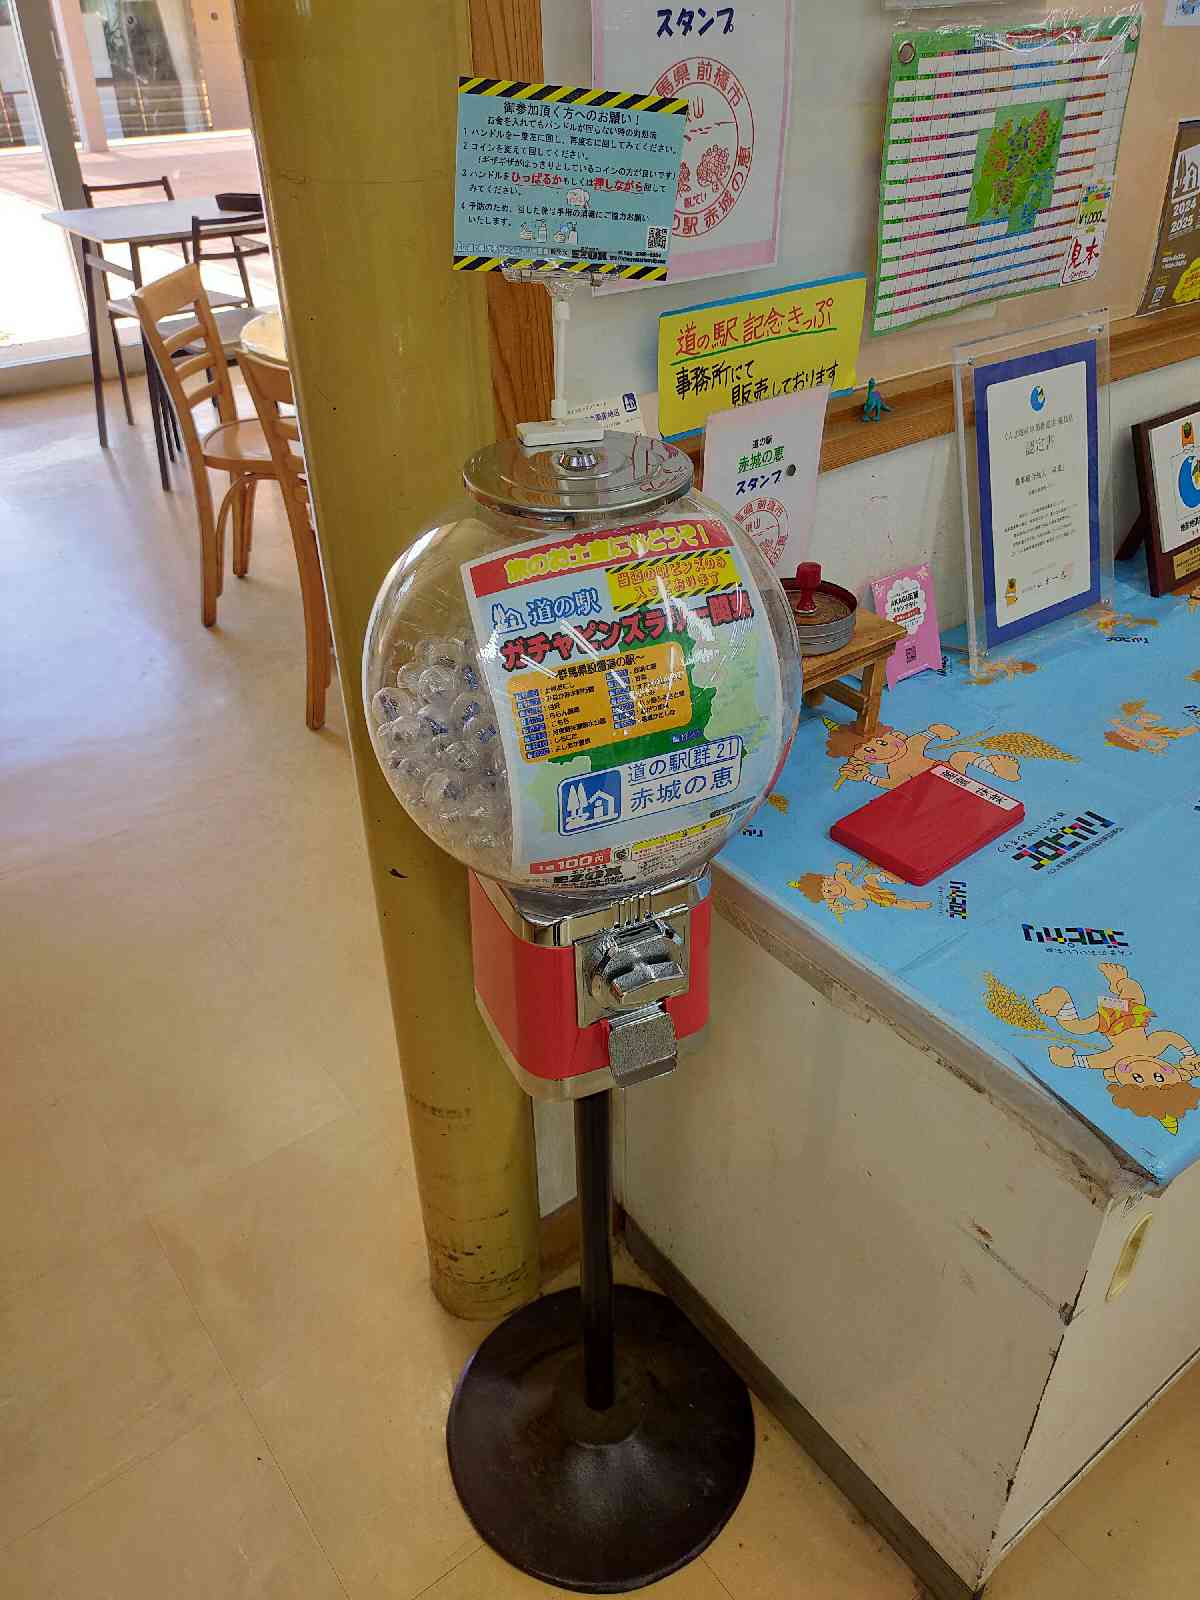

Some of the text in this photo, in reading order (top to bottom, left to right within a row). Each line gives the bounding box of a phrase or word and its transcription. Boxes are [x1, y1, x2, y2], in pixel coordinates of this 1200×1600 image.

[656, 8, 736, 37] スタンプ
[1070, 237, 1099, 268] 見本
[675, 297, 834, 357] 道の駅記念きっぷ
[675, 359, 755, 400] 事務所にて
[731, 360, 840, 408] 販売しております
[736, 446, 785, 473] 赤城の恵
[735, 469, 783, 496] スタンプ
[526, 586, 602, 627] 道の駅
[627, 750, 689, 783] 道の駅
[629, 764, 734, 814] 赤城の恵
